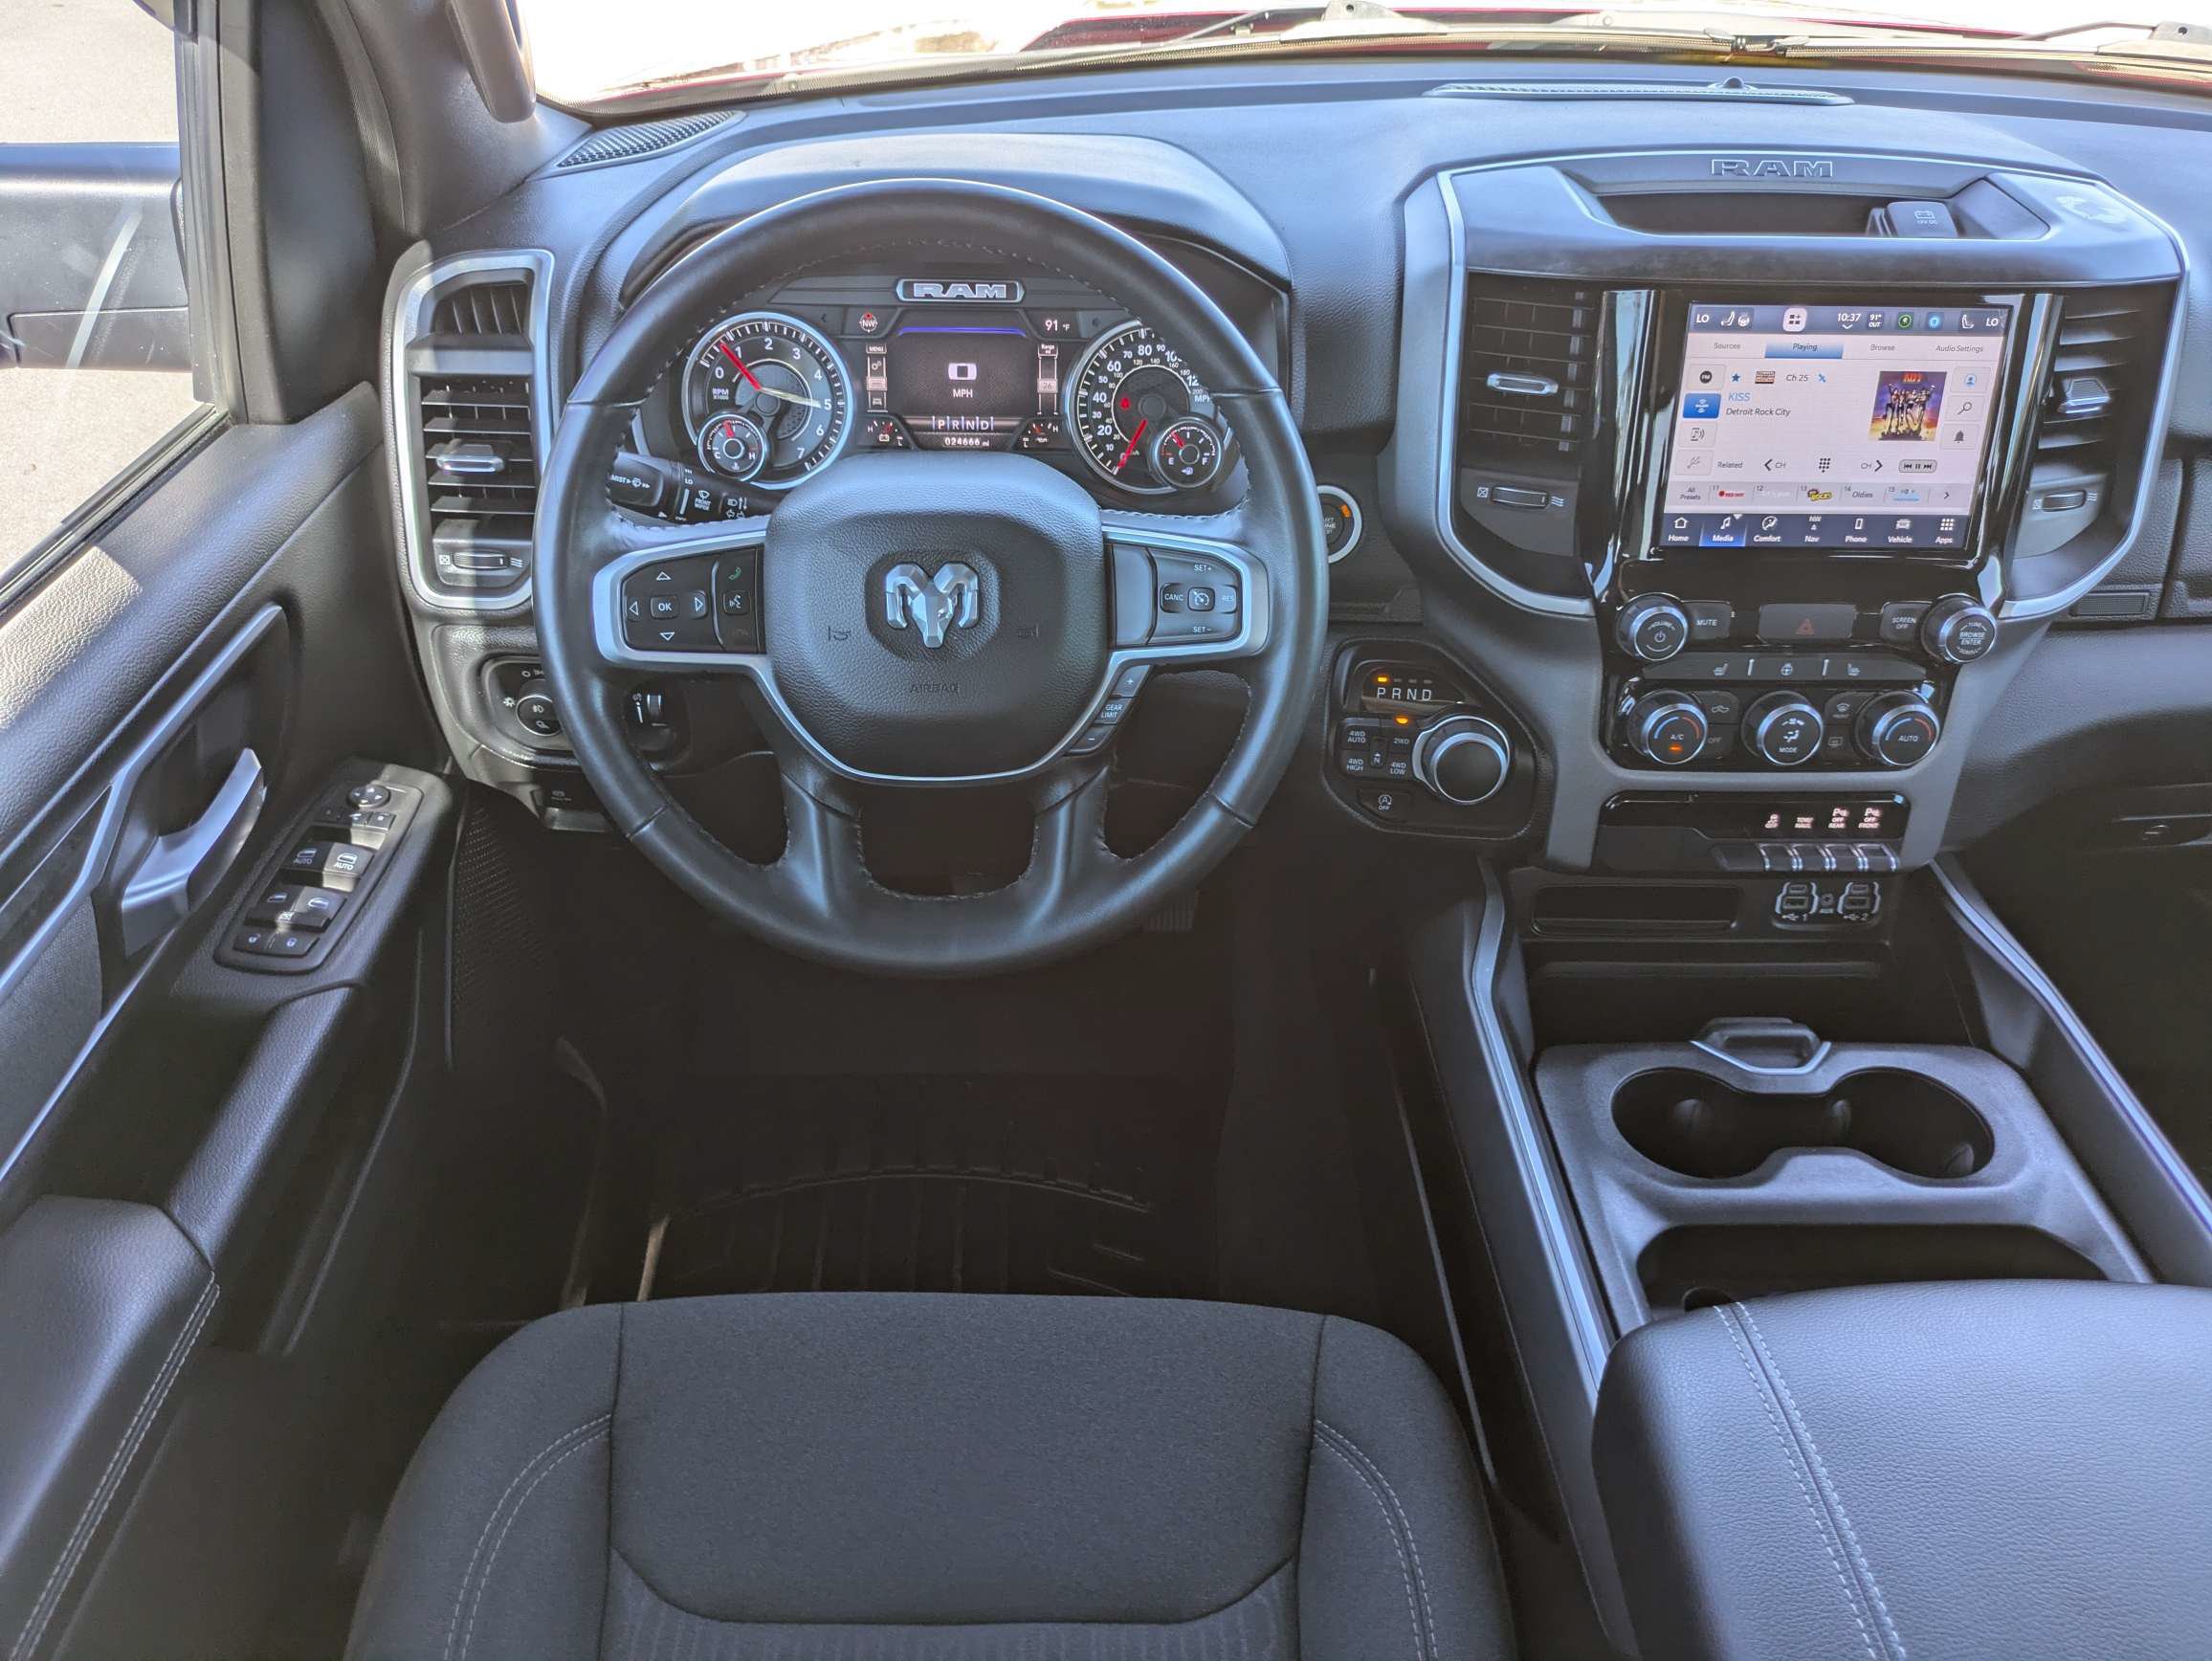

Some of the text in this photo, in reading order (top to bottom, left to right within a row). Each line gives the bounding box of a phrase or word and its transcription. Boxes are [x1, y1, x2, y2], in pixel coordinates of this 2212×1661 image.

[1711, 159, 1833, 177] RAM
[913, 283, 1006, 299] RAM
[1695, 314, 1710, 323] LO
[1836, 313, 1862, 322] 10:37
[1985, 318, 1999, 327] LO
[1045, 320, 1058, 332] 91
[764, 340, 774, 350] 2
[1138, 344, 1153, 356] 80
[1714, 342, 1741, 350] Sources
[1792, 343, 1818, 352] Playing
[1936, 344, 1984, 353] Audio Settings
[735, 346, 742, 359] 1
[793, 348, 801, 360] 3
[1123, 350, 1134, 359] 70
[1107, 361, 1121, 372] 60
[715, 366, 724, 379] 0
[814, 369, 823, 381] 4
[947, 363, 978, 381] 0
[1098, 375, 1109, 384] 50
[953, 388, 973, 398] MPH
[1093, 392, 1107, 404] 40
[1728, 392, 1751, 402] KISS
[824, 398, 832, 410] 5
[1092, 410, 1102, 419] 30
[1726, 408, 1791, 417] Detroit Rock City
[938, 419, 989, 430] P R N D
[816, 425, 824, 436] 6
[1097, 425, 1113, 436] 20
[944, 437, 981, 447] 024666
[1106, 443, 1115, 452] 10
[748, 452, 756, 460] H
[797, 447, 806, 459] 7
[1202, 457, 1208, 466] F
[1804, 535, 1821, 543] Nav
[1936, 536, 1953, 544] Apps
[658, 602, 673, 611] OK
[1377, 687, 1432, 701] P R N D
[293, 857, 313, 866] AUTO
[333, 861, 354, 871] AUTO
[1861, 913, 1869, 921] 2
